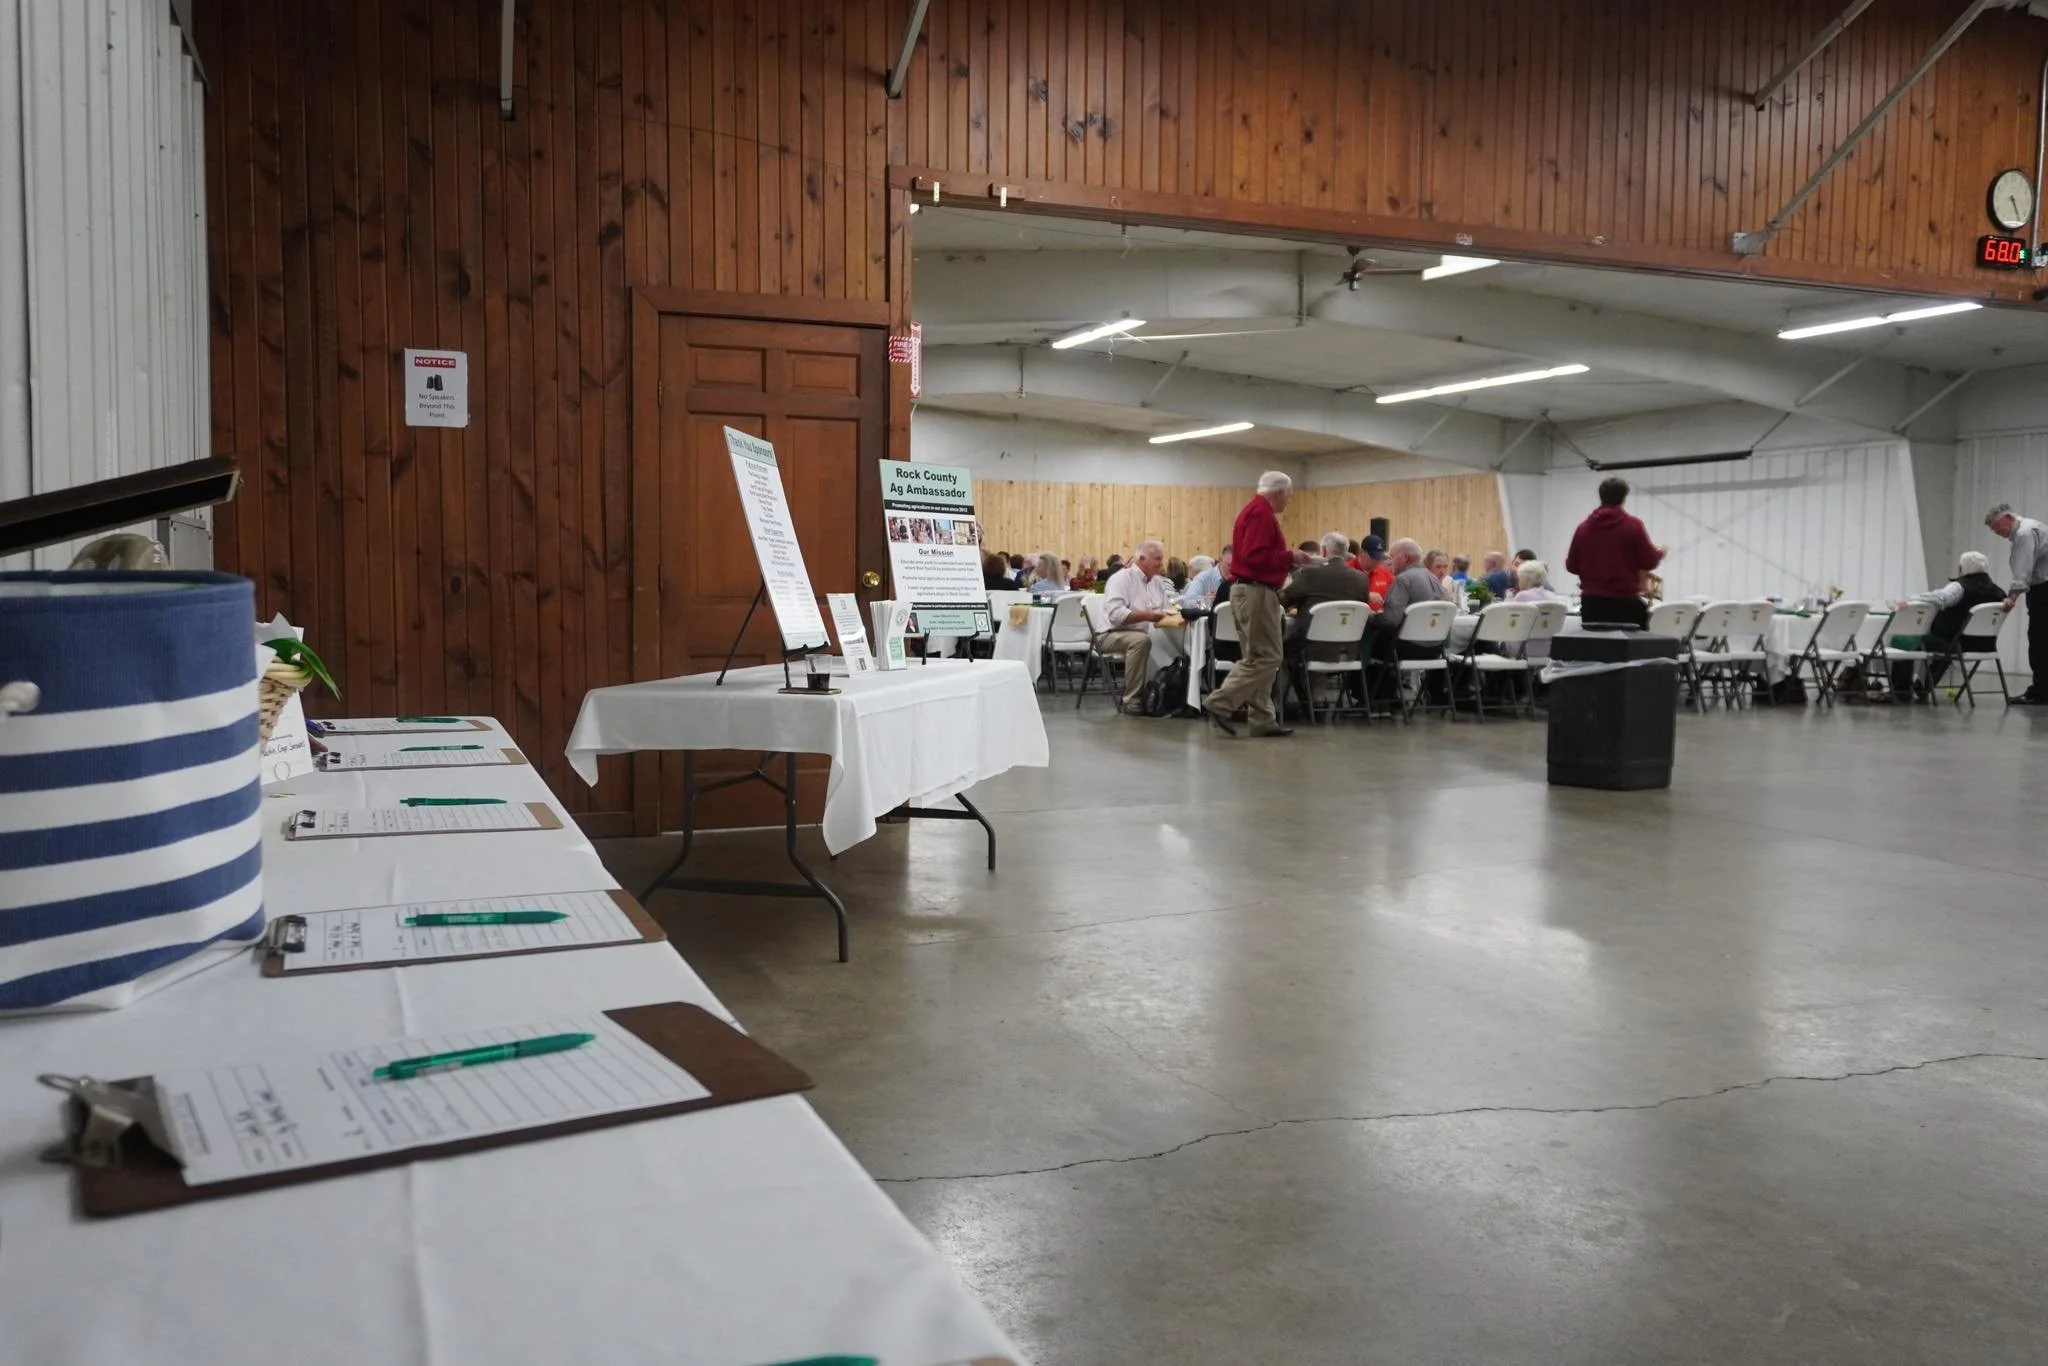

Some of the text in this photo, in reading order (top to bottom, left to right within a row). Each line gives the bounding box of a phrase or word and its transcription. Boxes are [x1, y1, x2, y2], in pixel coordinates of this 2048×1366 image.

[1984, 239, 2022, 263] 68.0
[415, 358, 455, 366] NOTICE
[428, 393, 455, 401] Speakers
[419, 402, 442, 410] Beyond
[896, 468, 958, 485] Rock County
[890, 482, 967, 498] Ag Ambassador
